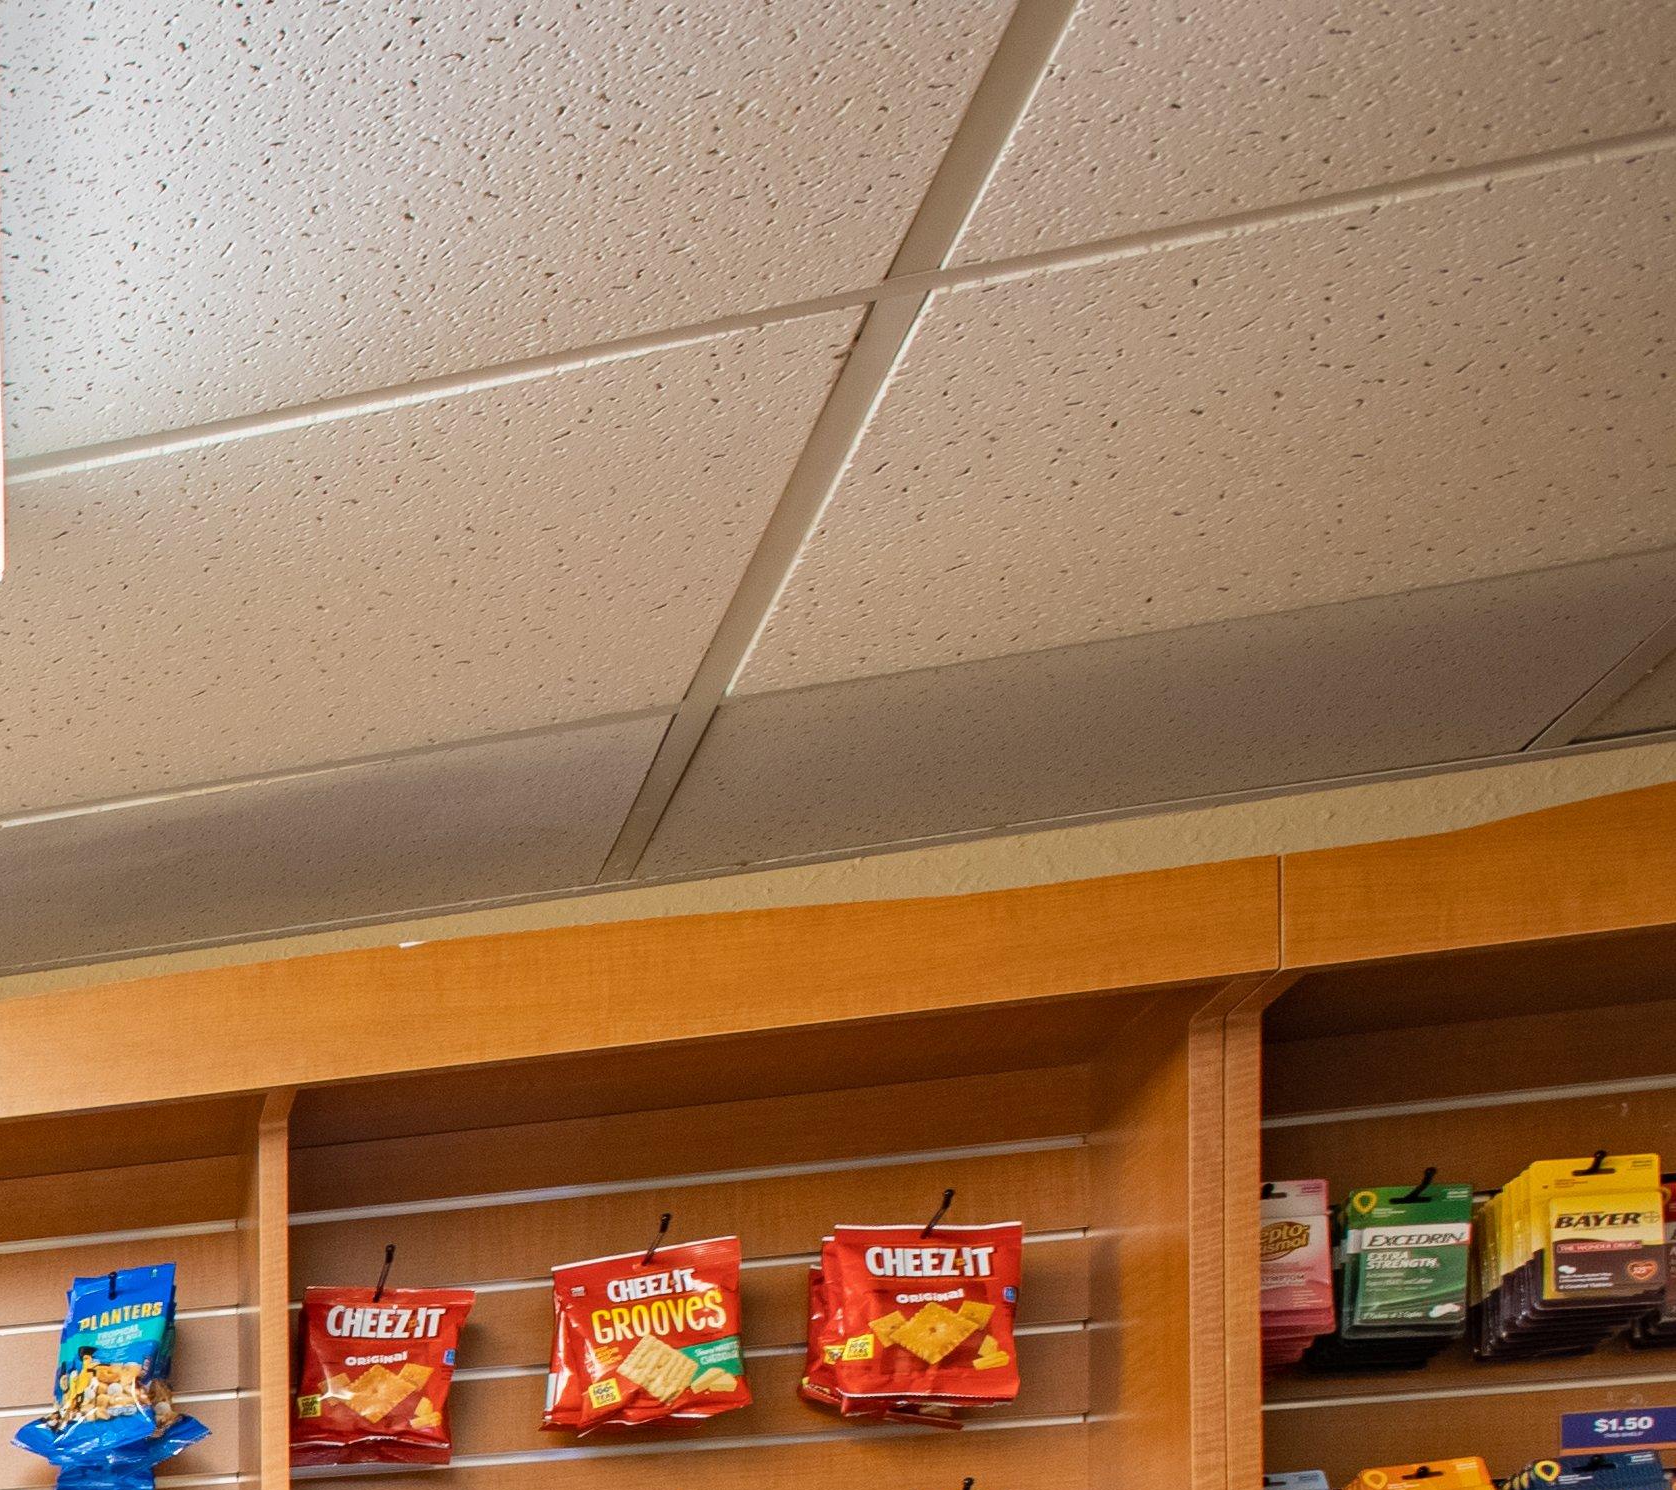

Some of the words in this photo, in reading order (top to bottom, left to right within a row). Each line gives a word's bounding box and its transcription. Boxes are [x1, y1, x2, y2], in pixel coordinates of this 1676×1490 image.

[1554, 1211, 1641, 1229] BAYER
[1367, 1231, 1466, 1248] EXCEDRIN
[1366, 1250, 1409, 1261] EXTRA
[77, 1301, 164, 1332] PLANTERS
[1593, 1417, 1655, 1432] $1.50
